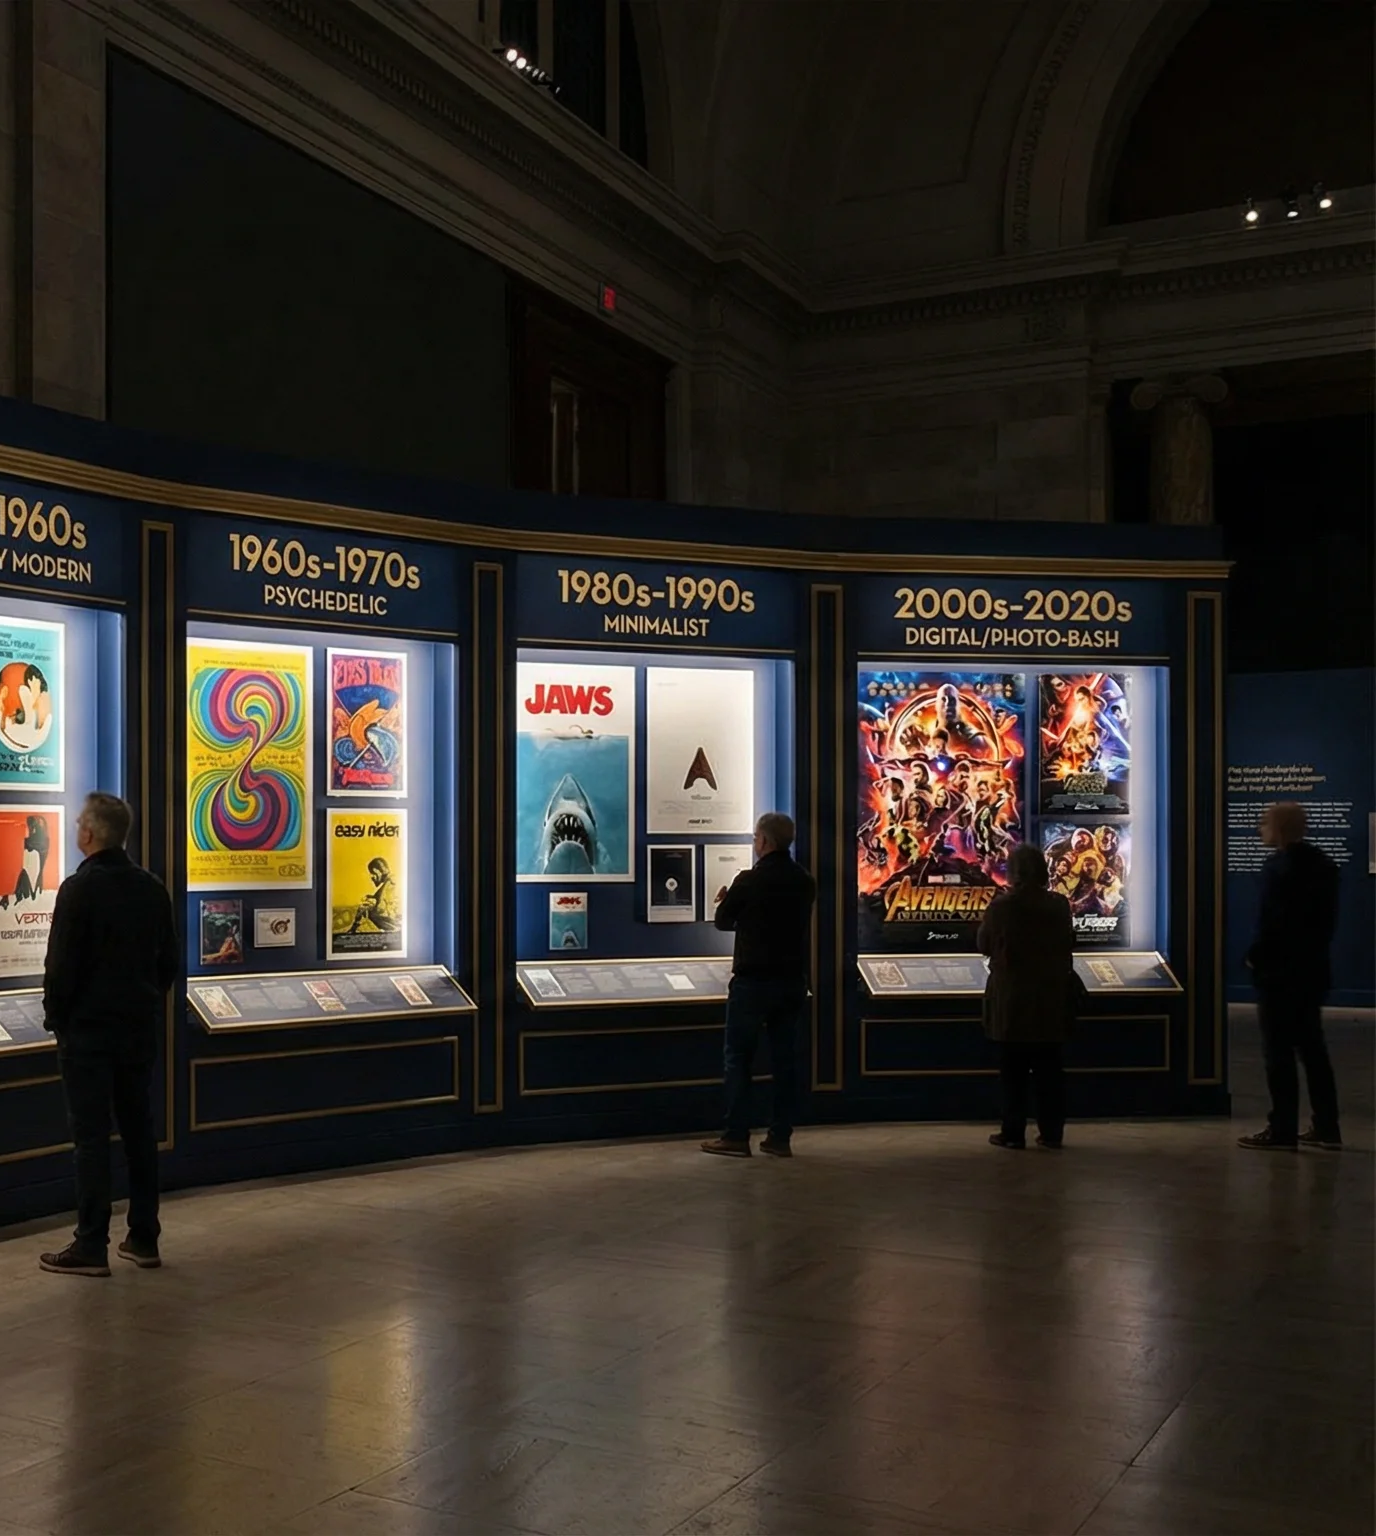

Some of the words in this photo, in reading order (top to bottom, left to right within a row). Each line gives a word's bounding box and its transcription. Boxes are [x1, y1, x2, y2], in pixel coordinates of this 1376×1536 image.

[12, 551, 92, 584] MODERN
[229, 533, 421, 590] 1960s-1970s
[264, 584, 387, 616] PSYCHEDELIC
[558, 569, 755, 613] 1980s-1990s
[893, 587, 1133, 623] 2000s-2020s
[604, 614, 710, 637] MINIMALIST
[905, 627, 1120, 649] DIGITAL/PHOTO-BASH
[525, 684, 614, 716] JAWS
[335, 824, 366, 838] easy
[884, 875, 996, 922] AVENGERS
